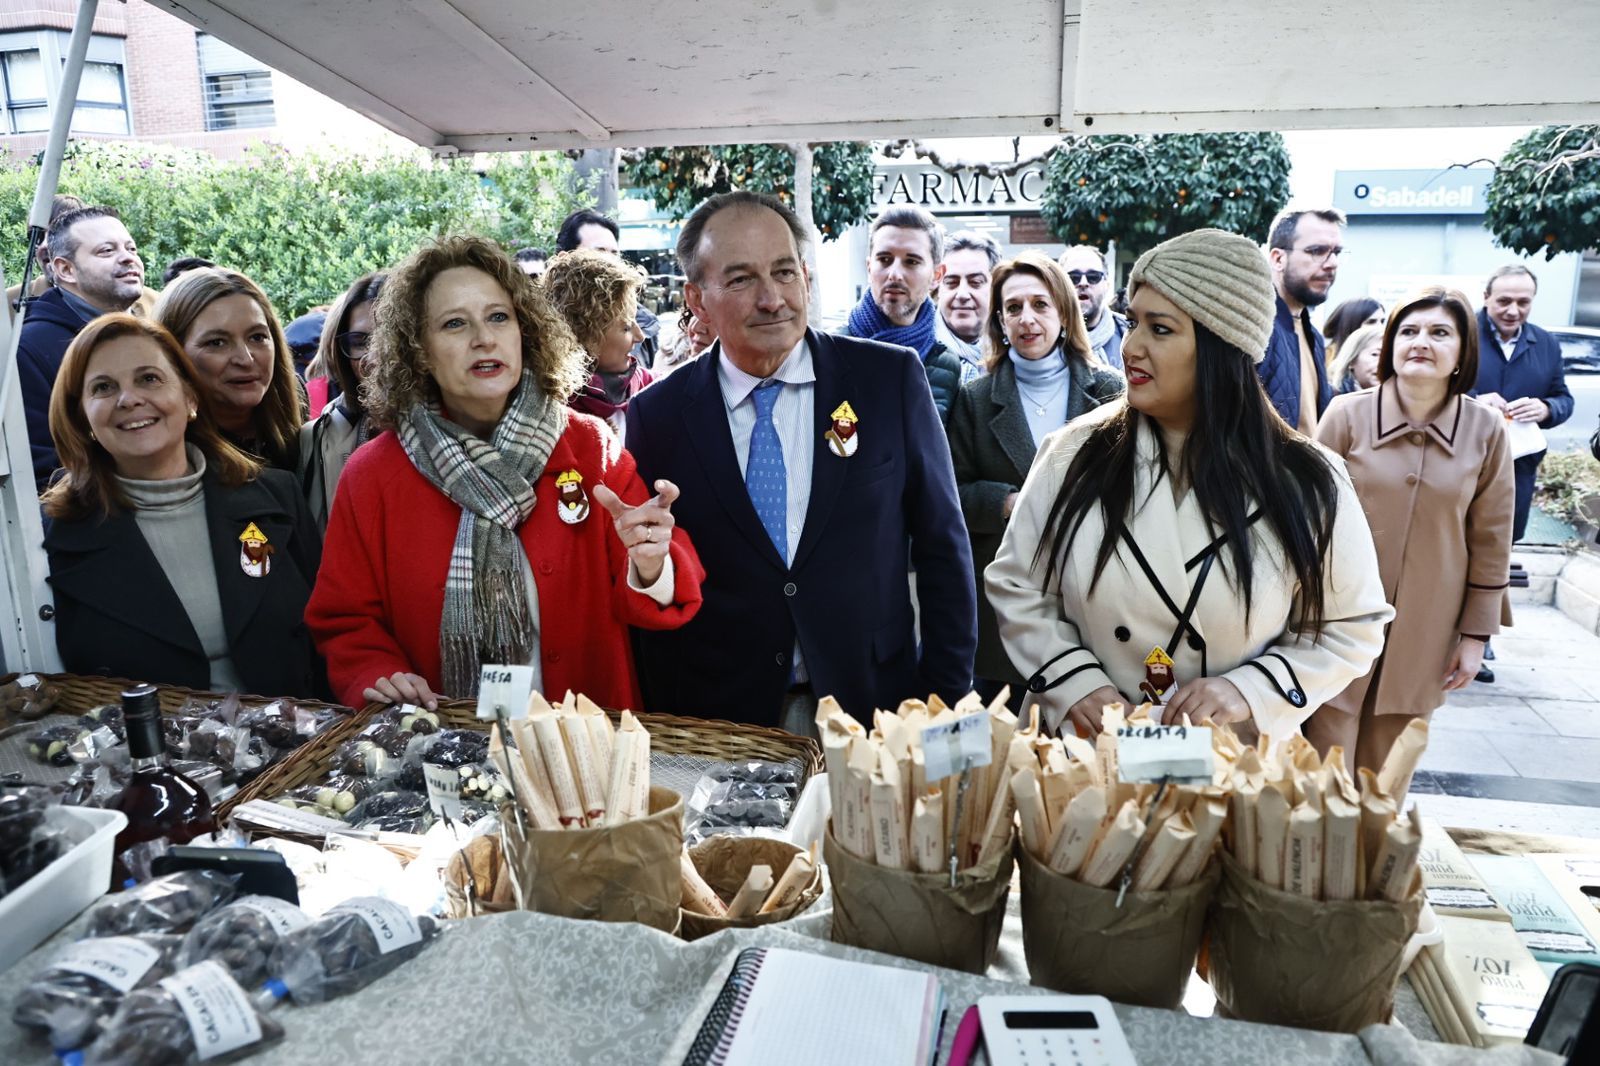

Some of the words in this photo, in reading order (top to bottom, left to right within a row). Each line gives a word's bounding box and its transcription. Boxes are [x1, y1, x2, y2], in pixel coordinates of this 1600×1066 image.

[1369, 185, 1473, 207] Sabadell
[1507, 903, 1556, 917] PURO
[192, 999, 221, 1045] CACAO
